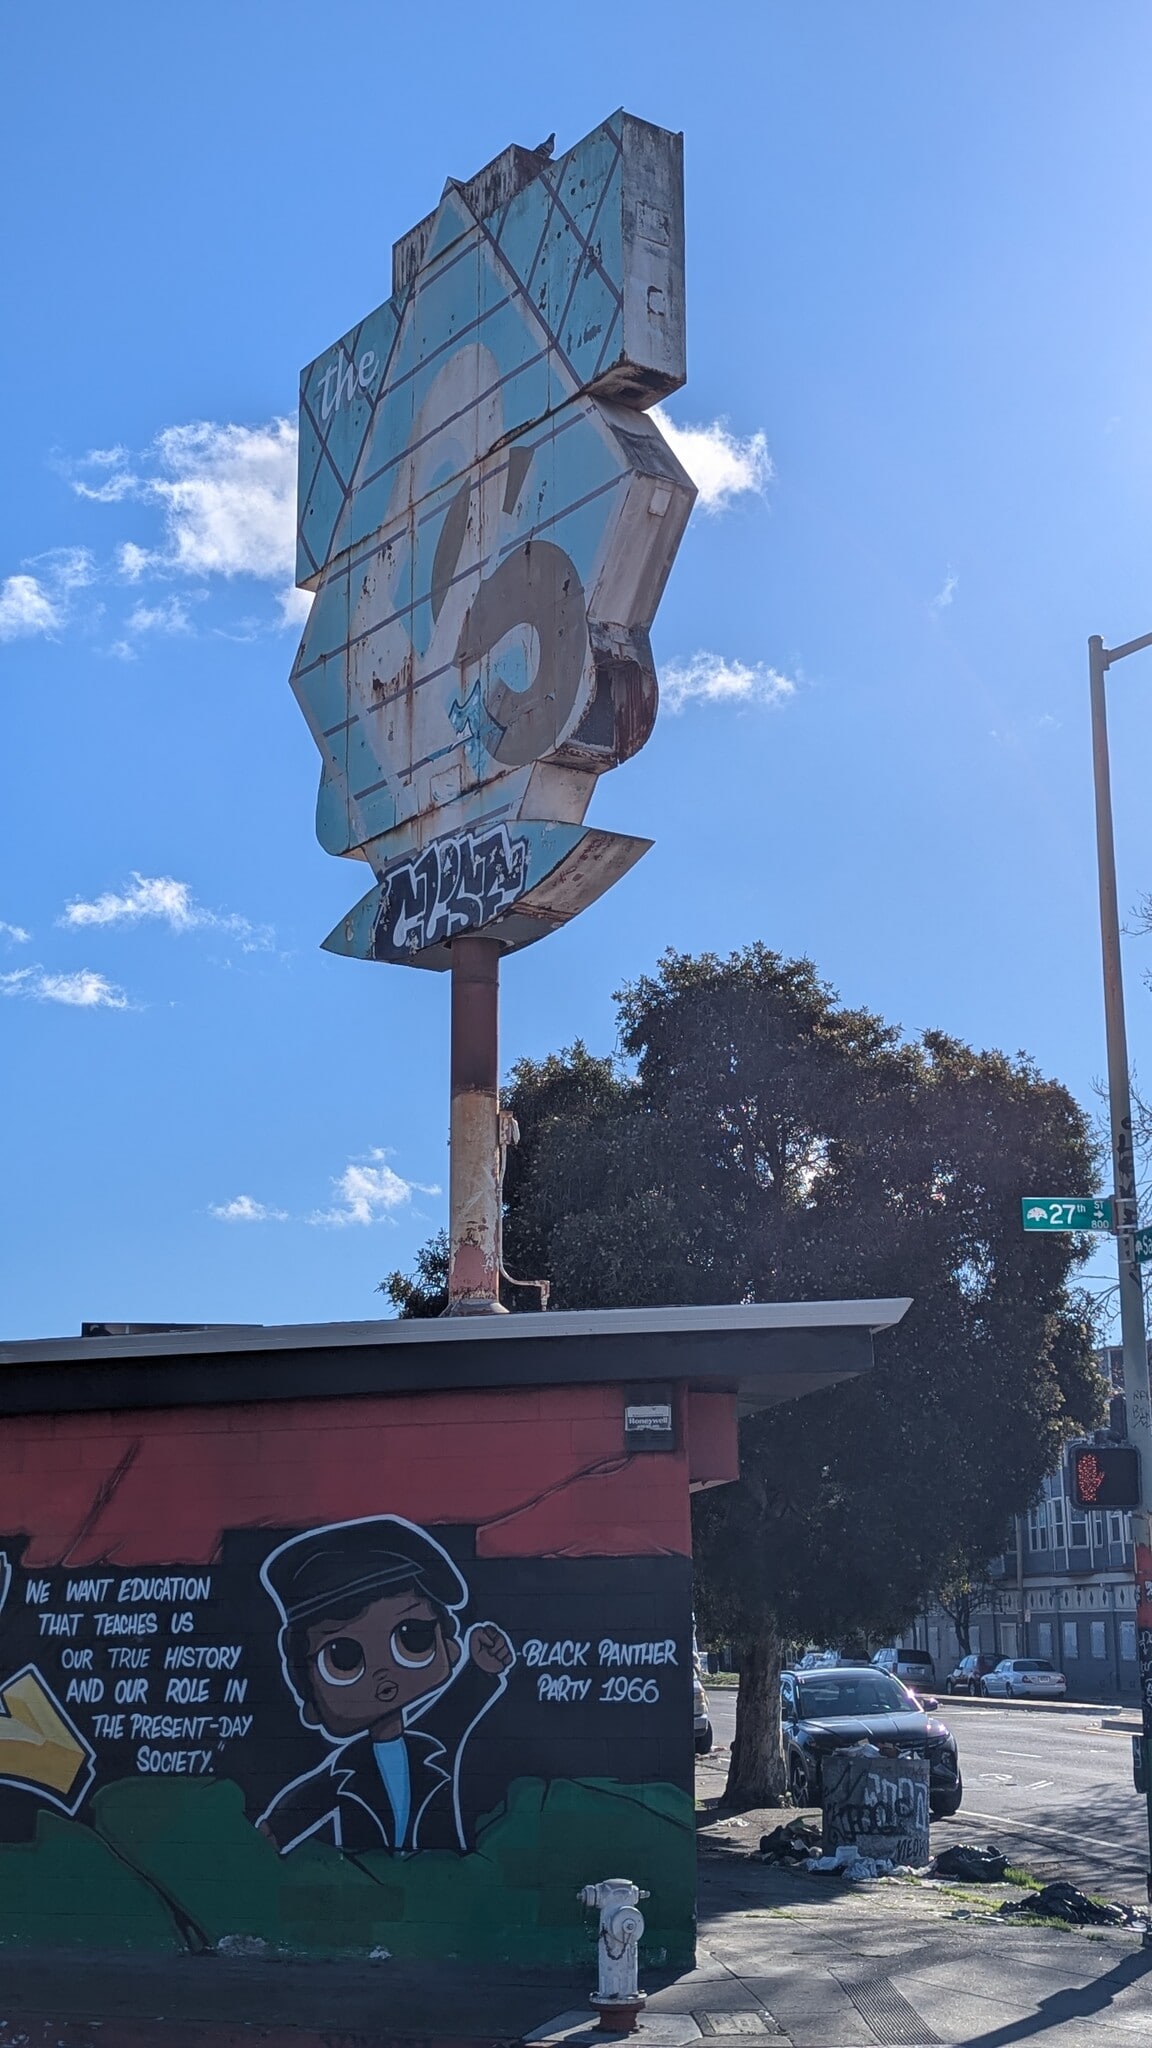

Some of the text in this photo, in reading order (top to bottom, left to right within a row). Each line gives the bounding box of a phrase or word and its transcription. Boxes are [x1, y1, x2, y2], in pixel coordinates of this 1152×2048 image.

[318, 348, 379, 420] the
[1049, 1201, 1105, 1225] 27th ST
[1091, 1220, 1109, 1229] 800
[628, 1416, 668, 1425] Honeywell
[25, 1576, 211, 1604] WE WANT EDUCATION
[38, 1611, 194, 1637] THAT TEACHES US
[61, 1645, 242, 1671] OUR TRUE HISTORY
[598, 1638, 679, 1667] PANTHER
[66, 1678, 248, 1704] AND OUR ROLE IN
[537, 1673, 660, 1703] PARTY 1966
[91, 1713, 253, 1740] THE PRESENT-DAY
